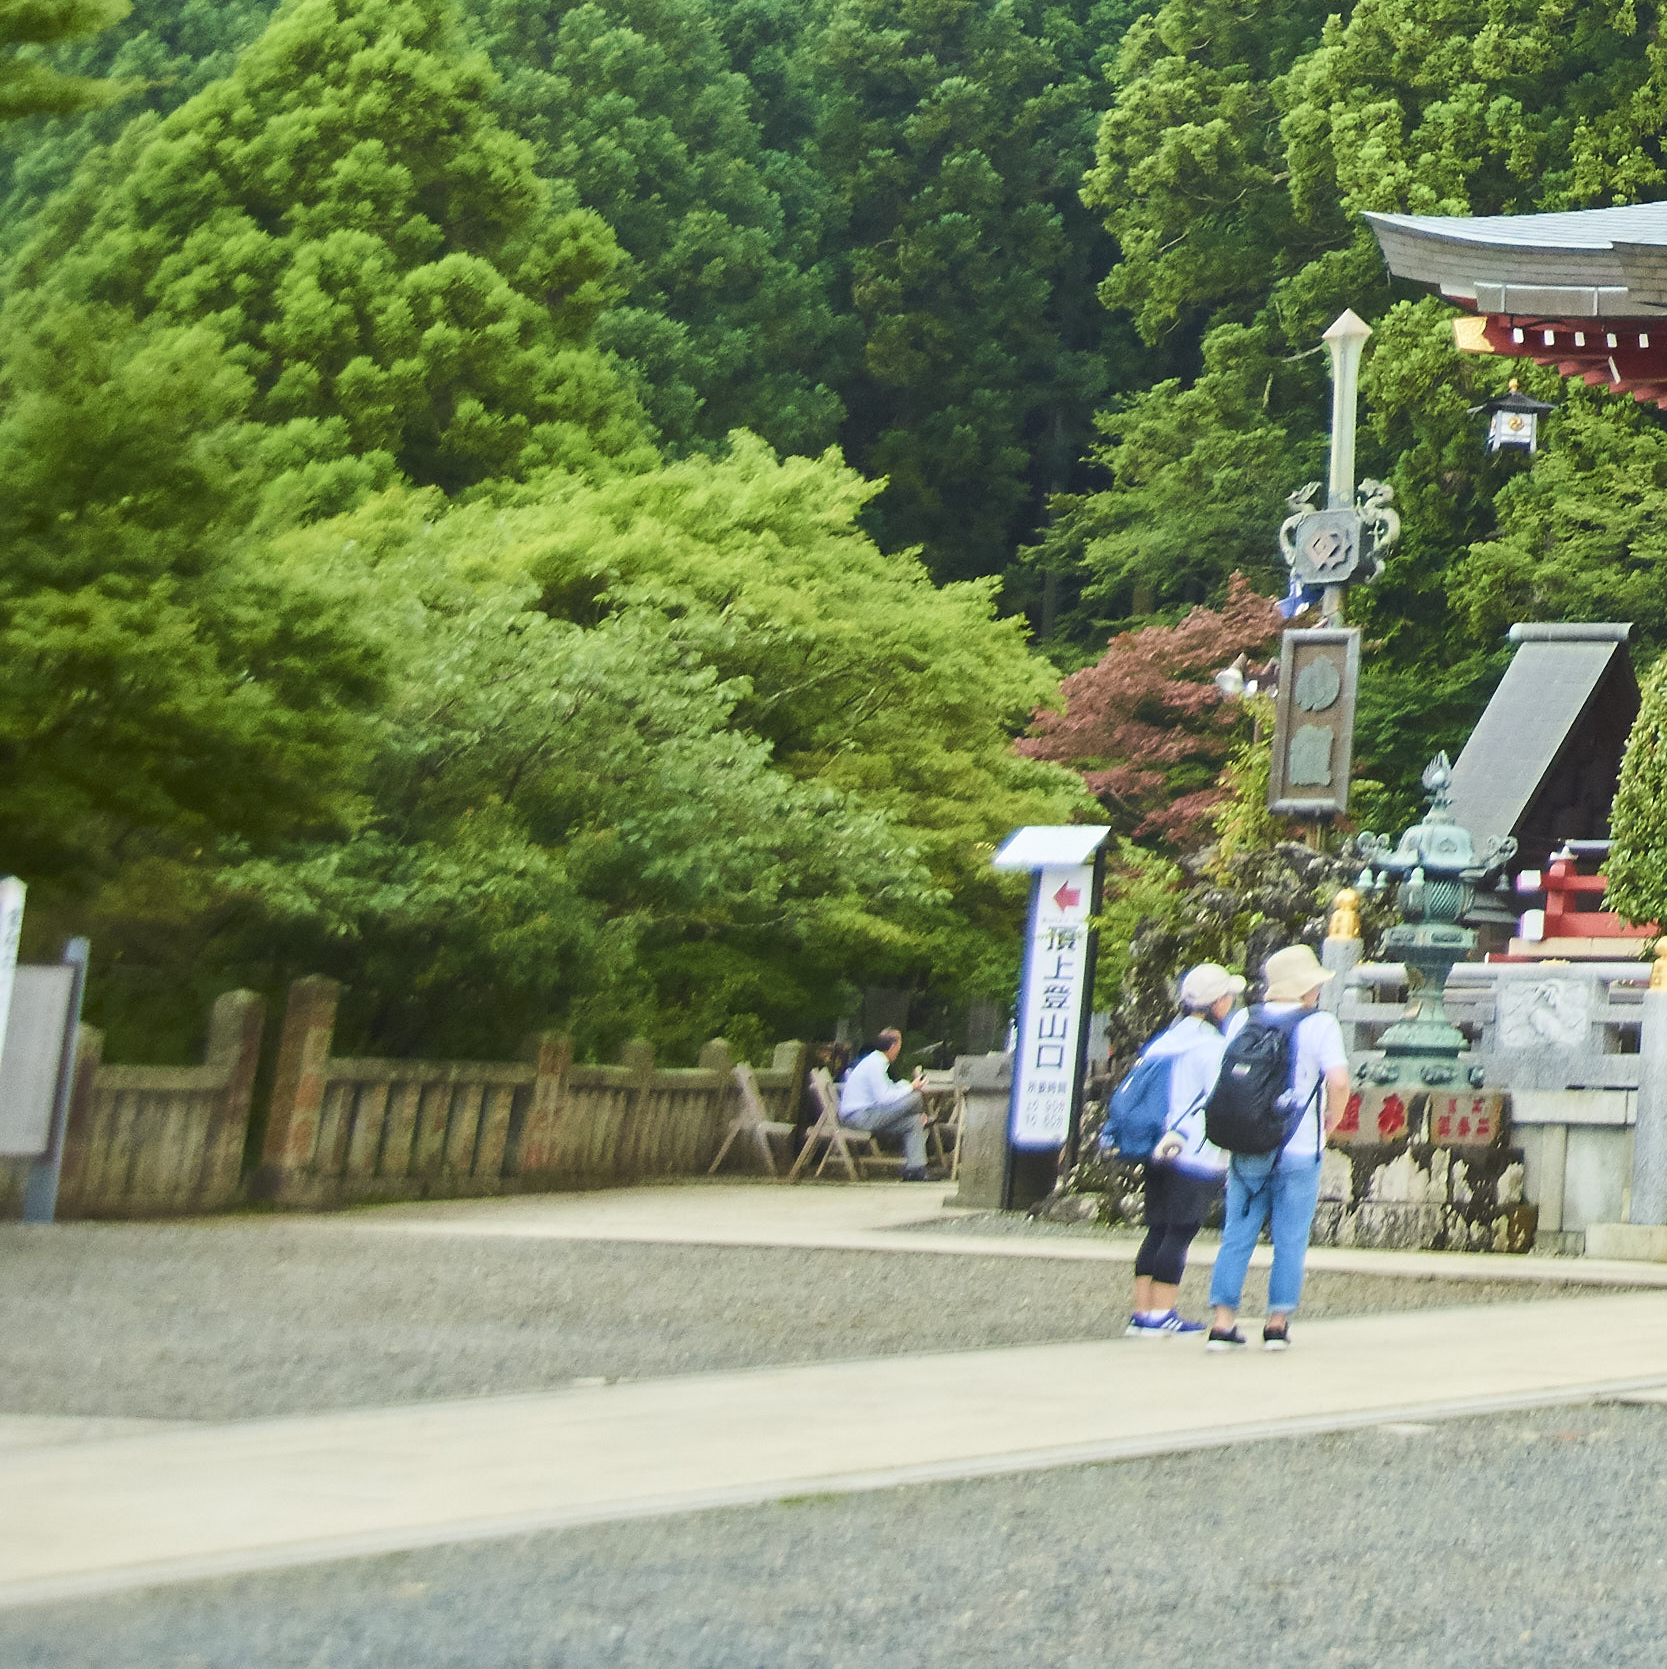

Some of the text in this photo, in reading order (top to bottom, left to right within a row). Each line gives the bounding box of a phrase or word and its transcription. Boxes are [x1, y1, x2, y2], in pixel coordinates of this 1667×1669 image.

[1036, 926, 1079, 1069] 頂上登山口
